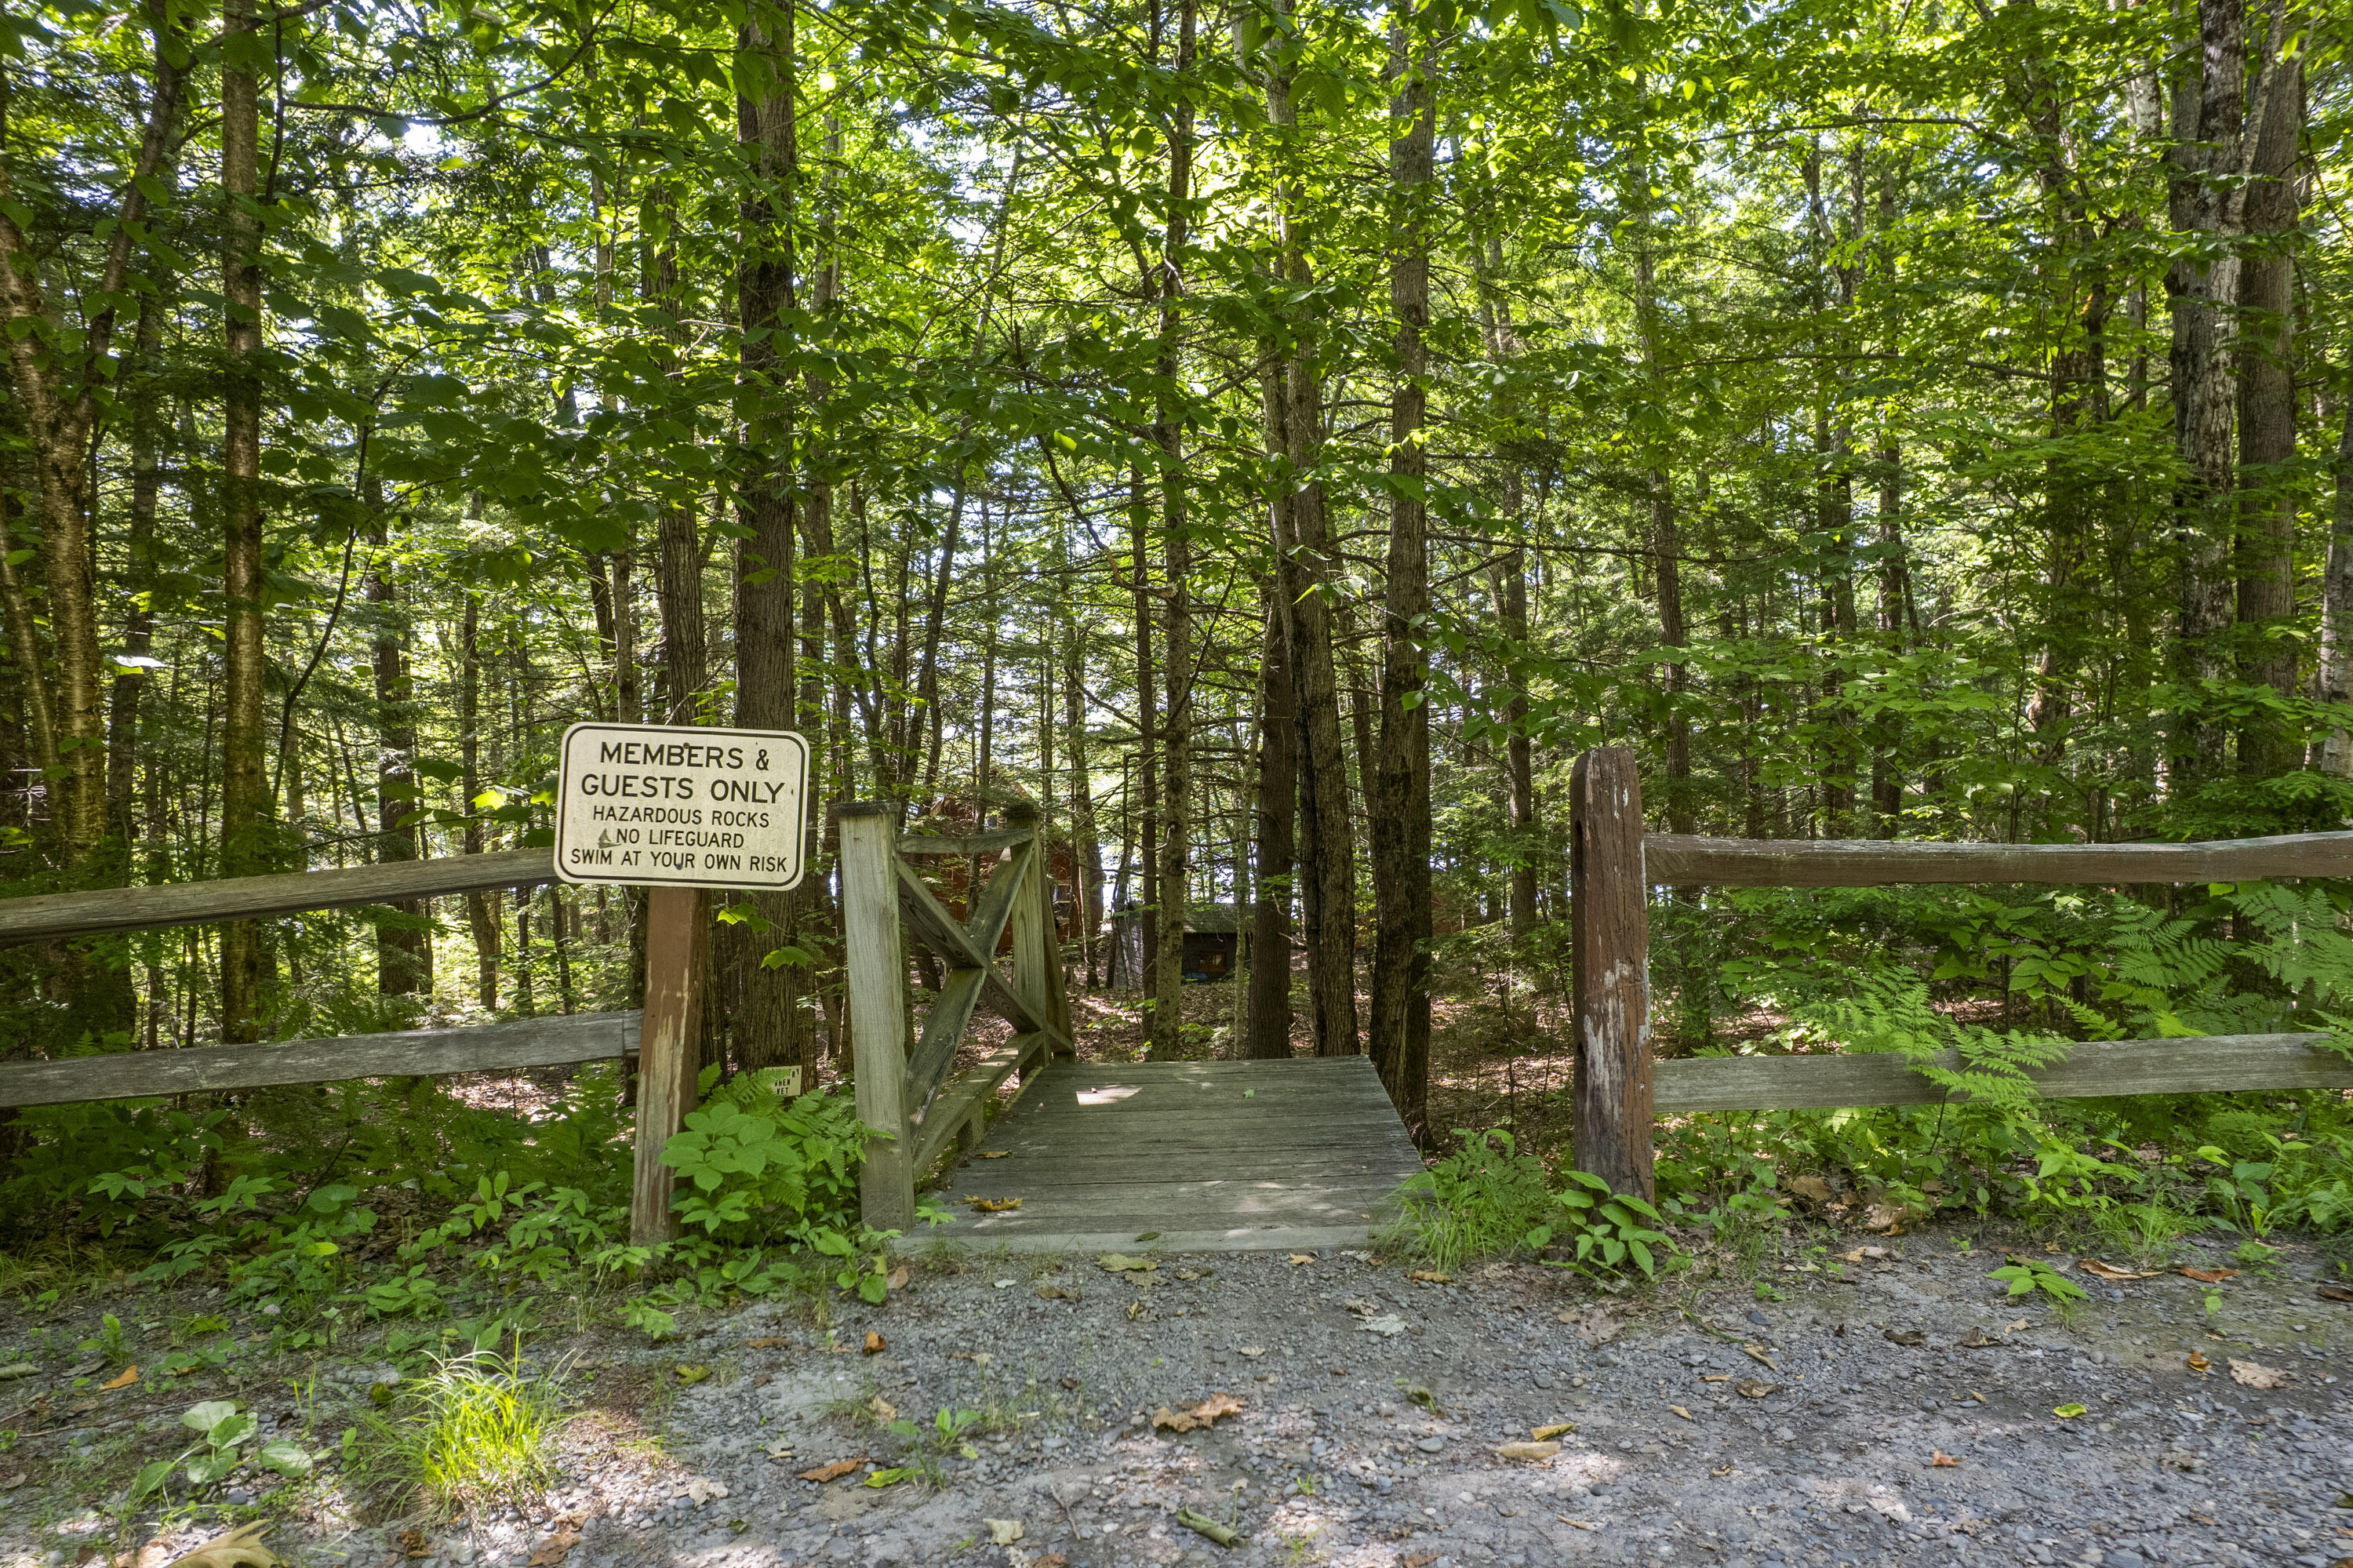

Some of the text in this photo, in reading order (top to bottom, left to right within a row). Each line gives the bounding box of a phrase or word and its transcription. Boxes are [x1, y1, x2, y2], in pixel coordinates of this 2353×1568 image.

[601, 741, 769, 771] MEMBERS &
[581, 773, 786, 804] GUESTS ONLY
[593, 805, 769, 828] HAZARDOUS ROCKS
[616, 828, 744, 849] NO LIFEGUARD
[570, 848, 787, 872] SWIM AT YOUR OWN RISK
